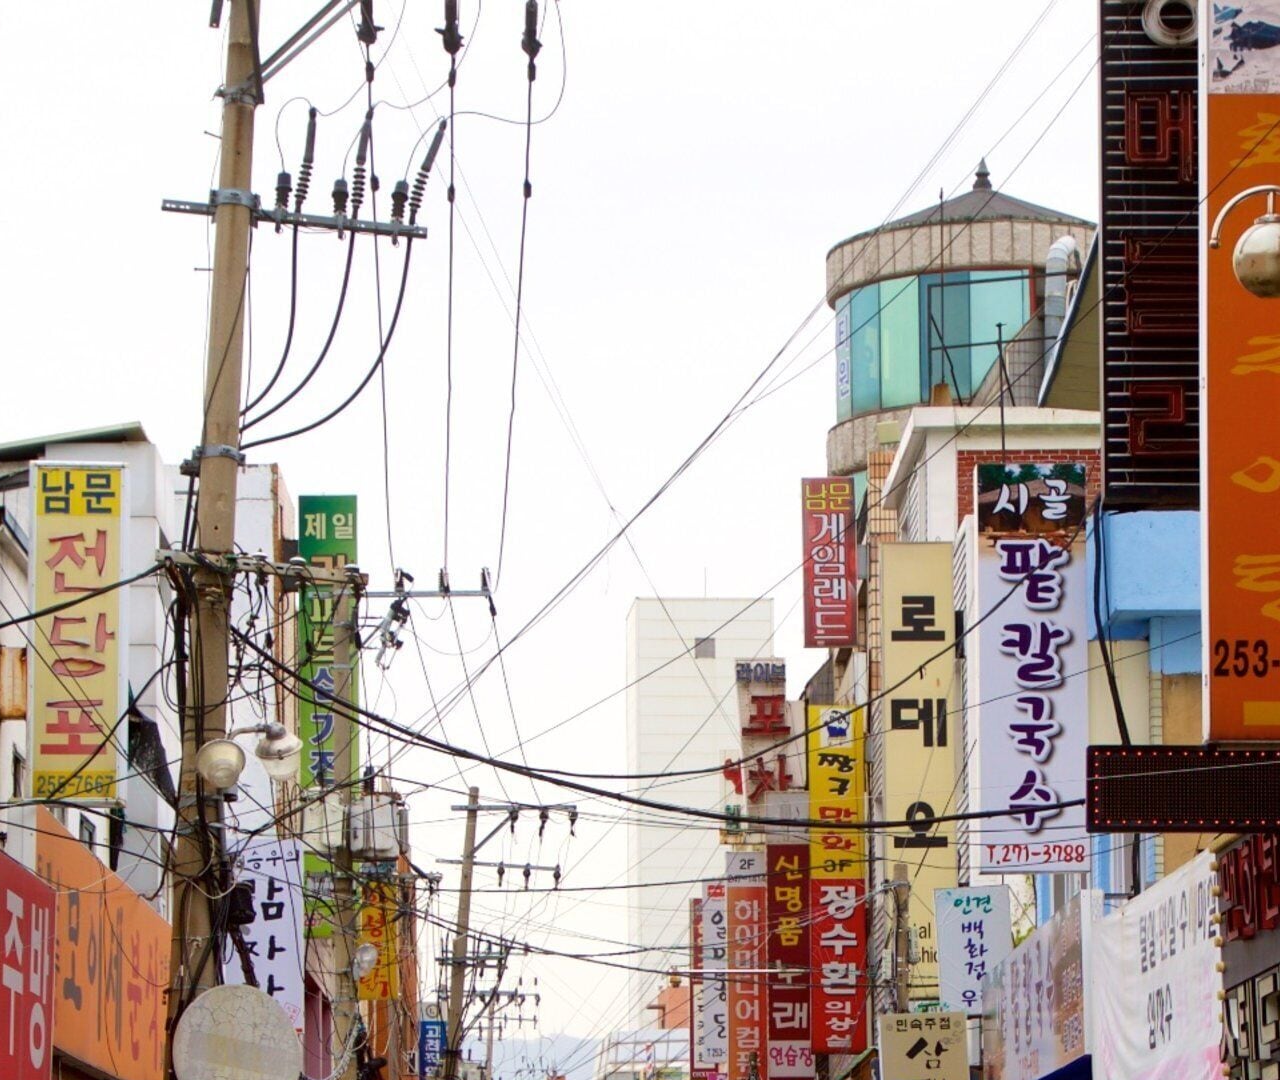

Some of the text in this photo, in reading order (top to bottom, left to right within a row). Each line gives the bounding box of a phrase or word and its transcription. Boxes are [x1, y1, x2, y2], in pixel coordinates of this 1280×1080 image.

[42, 472, 115, 515] 남문
[805, 481, 851, 512] 남문
[993, 478, 1072, 521] 시골
[304, 512, 355, 541] 제일
[810, 511, 851, 644] 게임랜드
[40, 529, 116, 755] 전당포
[737, 660, 786, 683] 라이브
[999, 541, 1070, 828] 팥칼국수
[891, 595, 949, 849] 로데오
[741, 694, 793, 802] 포차
[818, 752, 857, 796] 짱구
[818, 805, 858, 850] 만화
[740, 857, 756, 871] 2F
[986, 843, 1086, 866] T.271-3788
[774, 855, 805, 946] 신명품
[771, 960, 808, 1030] 노래
[896, 1018, 951, 1033] 민속주점
